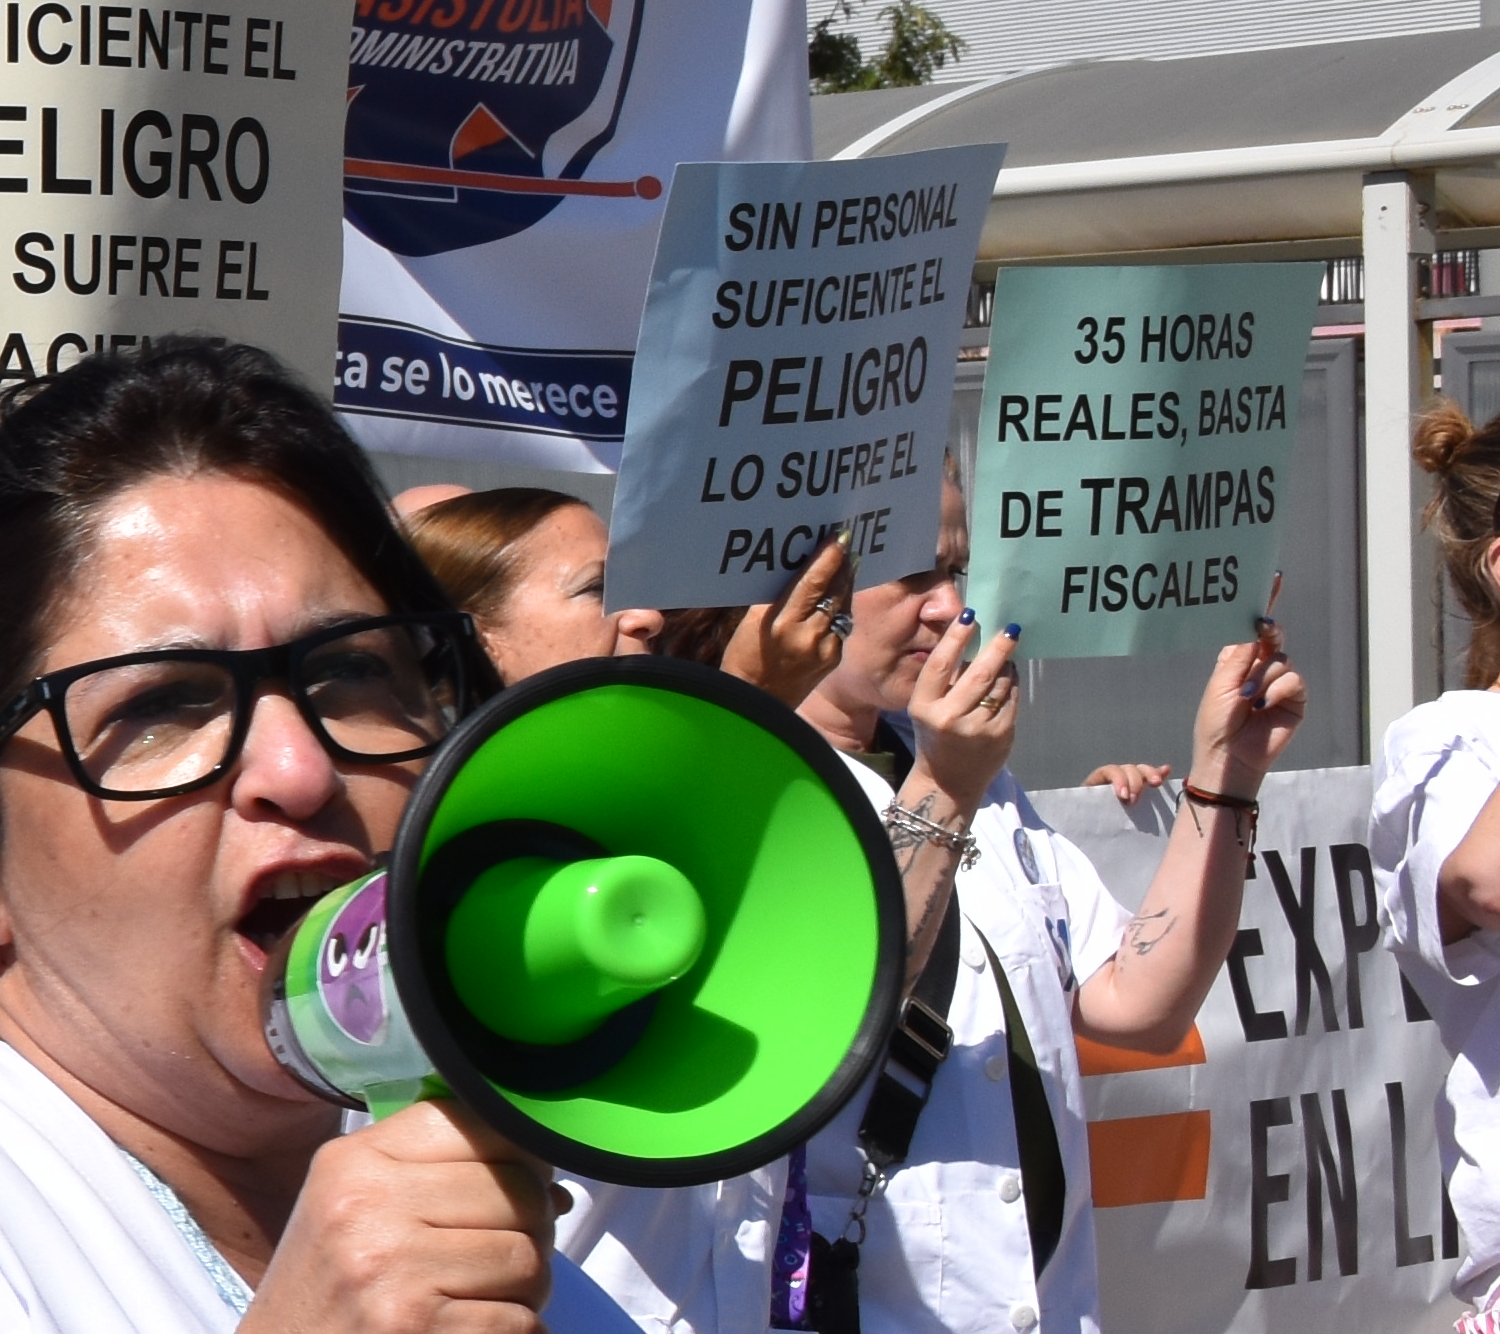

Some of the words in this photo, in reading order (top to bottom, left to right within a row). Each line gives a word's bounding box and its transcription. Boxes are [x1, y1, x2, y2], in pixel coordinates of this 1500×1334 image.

[243, 16, 297, 81] EL
[349, 26, 580, 86] DMINISTRATIVA
[724, 201, 802, 252] SIN
[811, 183, 958, 249] PERSONAL
[11, 231, 202, 299] SUFRE
[215, 239, 270, 301] EL
[711, 261, 918, 330] SUFICIENTE
[918, 257, 946, 307] EL
[1073, 316, 1126, 364] 35
[1139, 312, 1255, 363] HORAS
[380, 354, 431, 395] se
[438, 352, 476, 401] lo
[478, 370, 619, 418] merece
[718, 335, 928, 428] PELIGRO
[997, 391, 1188, 447] REALES,
[1197, 384, 1287, 437] BASTA
[700, 453, 765, 503] LO
[775, 437, 889, 500] SUFRE
[889, 431, 918, 480] EL
[1000, 489, 1064, 539] DE
[1079, 465, 1275, 537] TRAMPAS
[1060, 554, 1239, 614] FISCALES
[1244, 1087, 1359, 1291] EN
